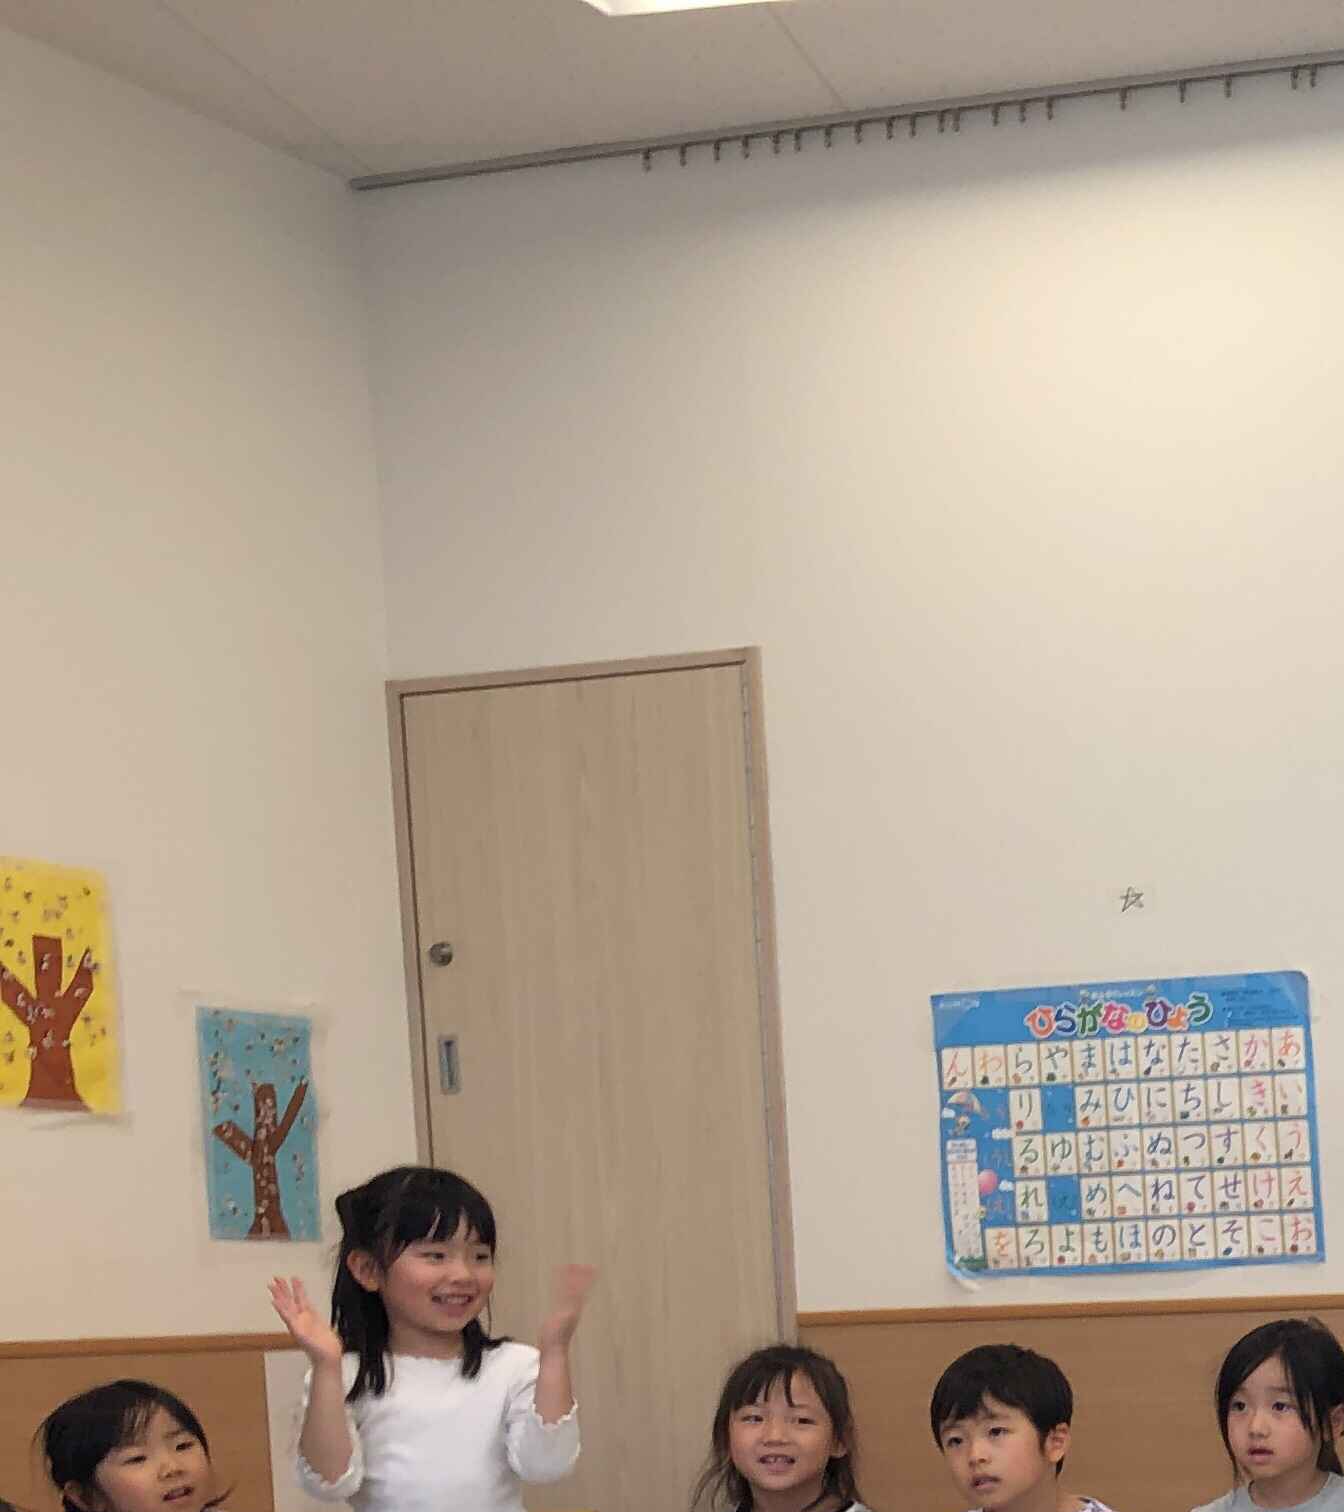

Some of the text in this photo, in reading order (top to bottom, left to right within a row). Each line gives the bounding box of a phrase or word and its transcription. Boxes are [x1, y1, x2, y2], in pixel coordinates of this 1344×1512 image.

[1025, 995, 1211, 1037] ひらがなのひょう
[945, 1030, 1301, 1077] ん わ ら や ま は な た さ か あ
[1019, 1093, 1033, 1120] り
[1080, 1089, 1102, 1113] み
[1113, 1087, 1135, 1111] ひ
[1147, 1087, 1167, 1108] に
[1181, 1083, 1201, 1110] ち
[1217, 1082, 1232, 1107] し
[1252, 1080, 1265, 1106] き
[1019, 1138, 1039, 1164] る
[1051, 1136, 1073, 1162] ゆ
[1085, 1134, 1105, 1161] む
[1114, 1134, 1138, 1157] ふ
[1148, 1132, 1172, 1154] ぬ
[1183, 1133, 1206, 1150] つ
[1216, 1127, 1239, 1153] す
[1256, 1127, 1267, 1150] く
[1020, 1169, 1308, 1208] れ め へ ね て せ け え
[1024, 1229, 1044, 1255] ろ
[1058, 1227, 1076, 1252] よ
[1093, 1226, 1108, 1252] も
[1119, 1224, 1142, 1250] ほ
[1152, 1225, 1176, 1247] の
[1190, 1223, 1206, 1247] と
[1222, 1219, 1242, 1244] そ
[1261, 1218, 1276, 1241] こ
[1291, 1216, 1312, 1241] お
